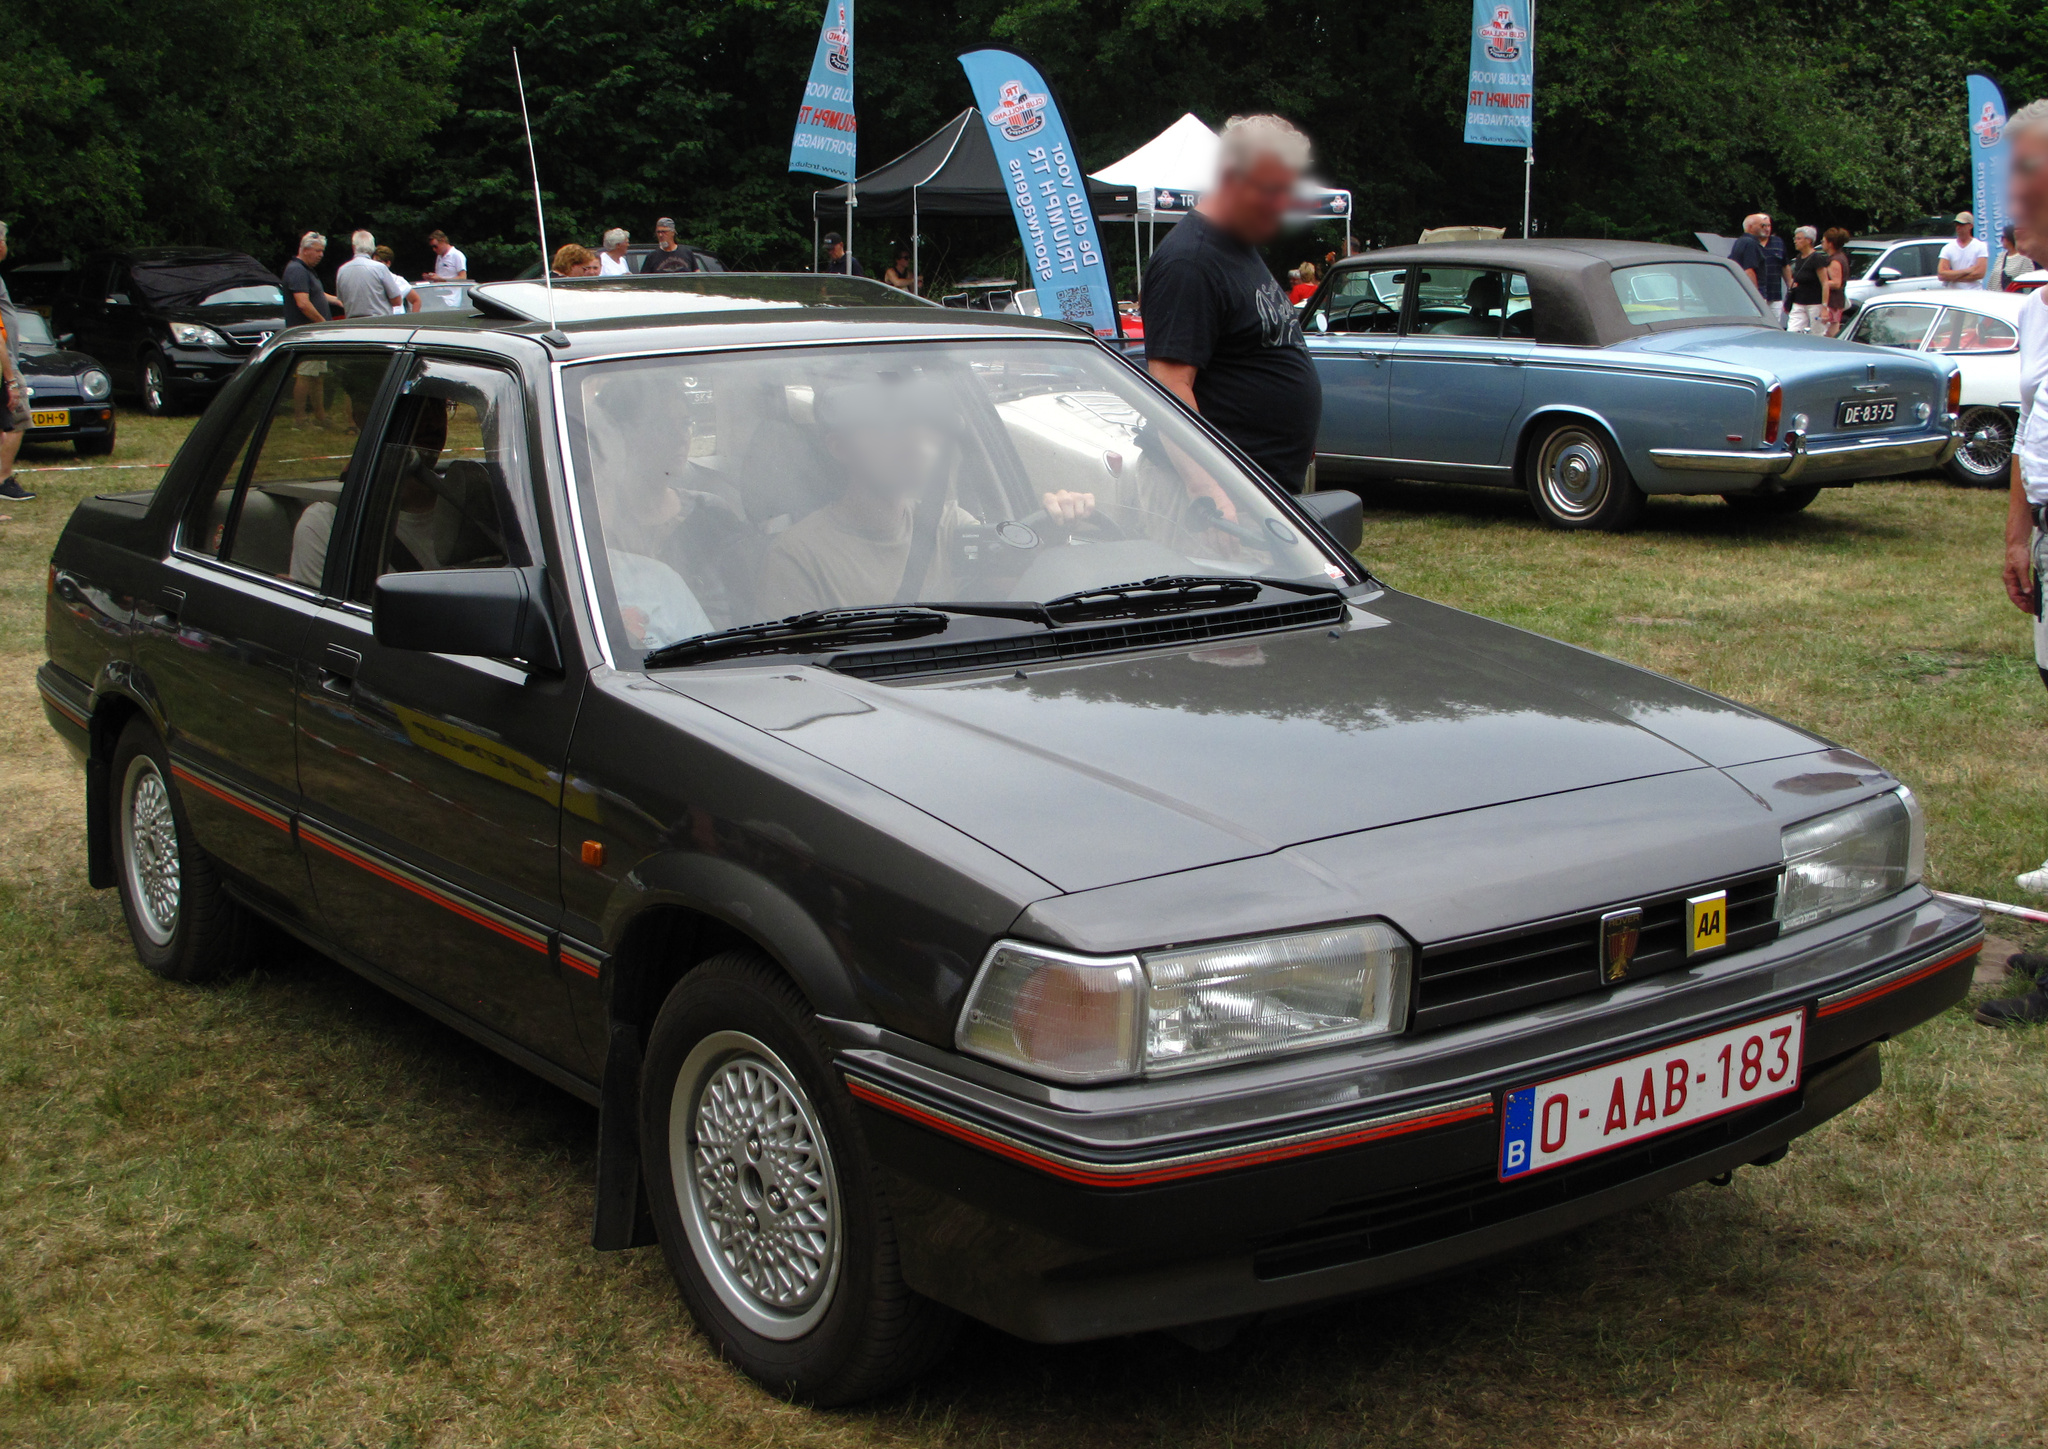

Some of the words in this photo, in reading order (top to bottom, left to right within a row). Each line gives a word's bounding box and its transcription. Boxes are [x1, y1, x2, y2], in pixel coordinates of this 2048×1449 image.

[1180, 194, 1195, 206] TR
[1844, 404, 1895, 423] DE-83-75
[1608, 913, 1641, 928] ROVER
[1696, 910, 1720, 938] AA
[1507, 1139, 1526, 1169] B
